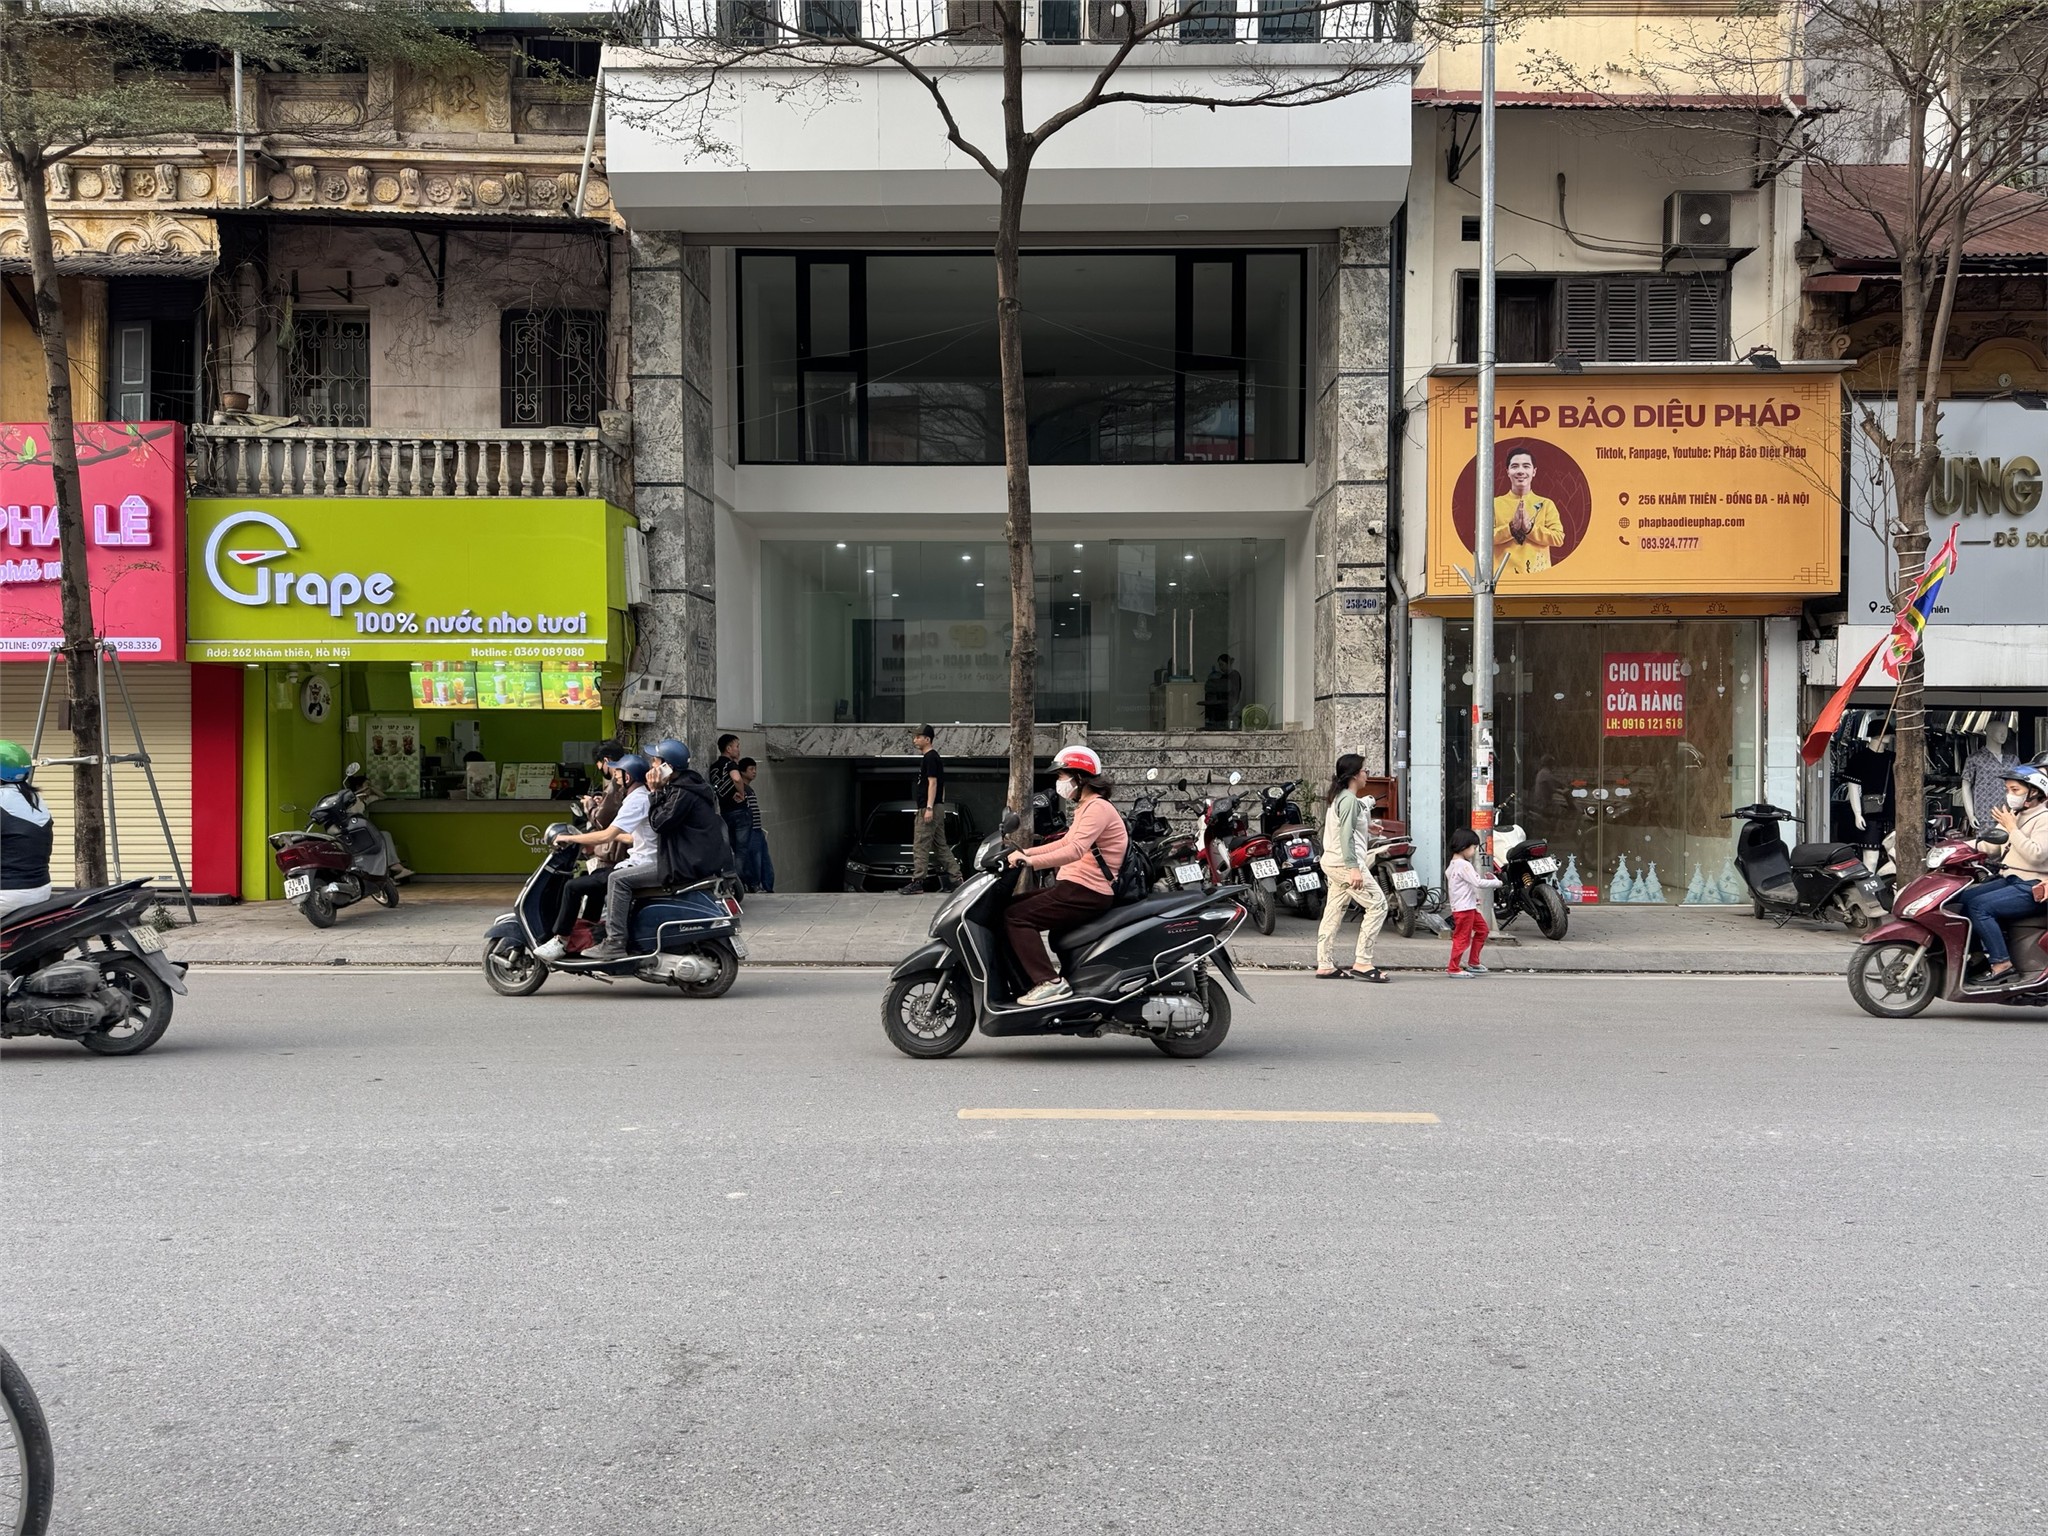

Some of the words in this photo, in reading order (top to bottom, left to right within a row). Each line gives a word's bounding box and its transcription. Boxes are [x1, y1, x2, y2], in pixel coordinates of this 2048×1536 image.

[1558, 396, 1626, 430] BẢO
[1633, 398, 1706, 434] DIỆU
[1714, 397, 1801, 428] PHÁP
[1596, 446, 1627, 460] Tiktok,
[1629, 446, 1670, 461] Fanpage,
[1672, 446, 1711, 459] Youtube:
[1713, 446, 1738, 460] Pháp
[1739, 444, 1758, 459] Bảo
[1760, 445, 1781, 461] Diệu
[1783, 445, 1807, 460] Pháp
[1930, 455, 2043, 516] UNG
[1638, 494, 1656, 505] 256
[1658, 492, 1687, 505] KHÂM
[1689, 492, 1717, 505] THIÊN
[1726, 490, 1753, 505] ĐỐNG
[1755, 494, 1768, 504] ĐA
[1777, 491, 1791, 504] HÀ
[1792, 491, 1810, 506] NỘI
[94, 495, 151, 546] LÊ
[1638, 516, 1745, 529] phapbaodieuphap.com
[1641, 537, 1699, 549] 083.924.7777
[205, 510, 394, 617] Grape
[1345, 598, 1377, 609] 258-260
[354, 611, 419, 634] 100%
[425, 609, 484, 634] nước
[488, 611, 533, 634] nho
[537, 611, 588, 634] tươi
[206, 647, 231, 657] Add:
[233, 647, 252, 657] 262
[254, 647, 282, 657] khâm
[284, 647, 313, 659] thiên,
[316, 647, 330, 657] Hà
[333, 647, 351, 659] Nội
[471, 647, 507, 657] Hotline
[514, 647, 540, 657] 0369
[542, 647, 563, 657] 089
[564, 647, 584, 657] 080
[1608, 662, 1640, 682] CHO
[1643, 659, 1681, 682] THUÊ
[1607, 688, 1638, 712] CỬA
[1641, 690, 1683, 712] HÀNG
[1606, 718, 1620, 729] LH:
[1622, 718, 1645, 729] 0916
[1647, 718, 1663, 729] 121
[1665, 718, 1683, 729] 518
